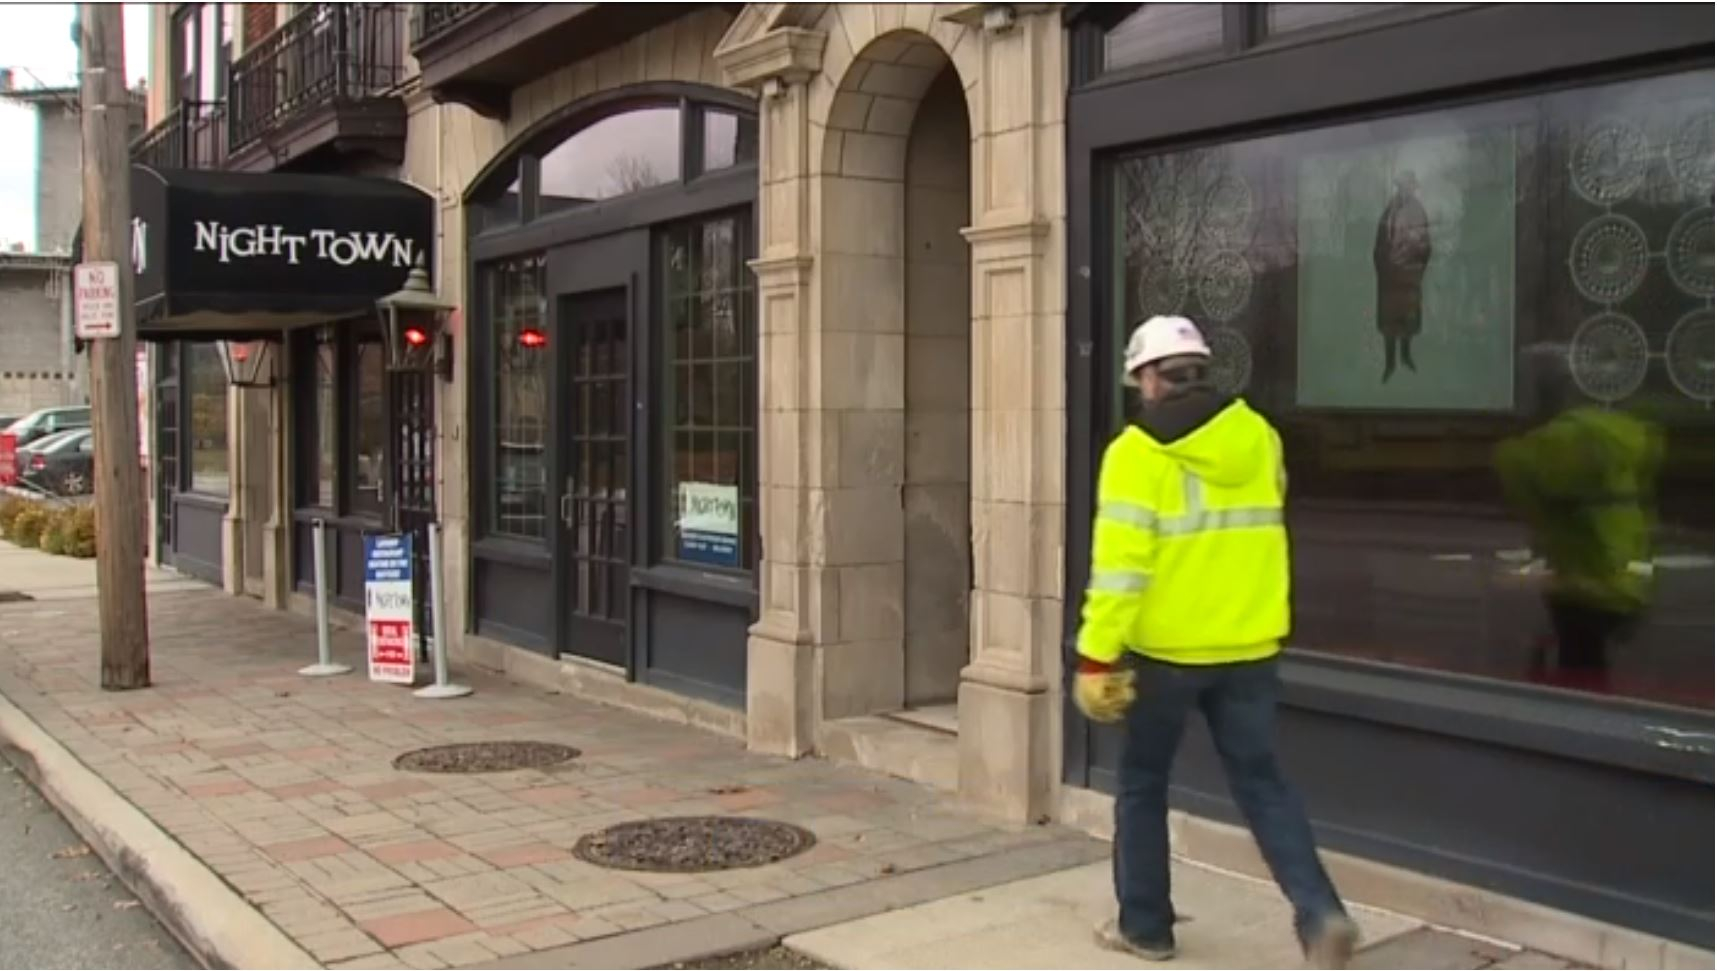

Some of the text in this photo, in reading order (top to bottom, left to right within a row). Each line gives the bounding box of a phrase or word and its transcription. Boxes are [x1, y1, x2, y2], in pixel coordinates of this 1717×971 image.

[311, 229, 413, 266] TOWN
[88, 271, 105, 284] NO
[79, 287, 115, 299] PARKING
